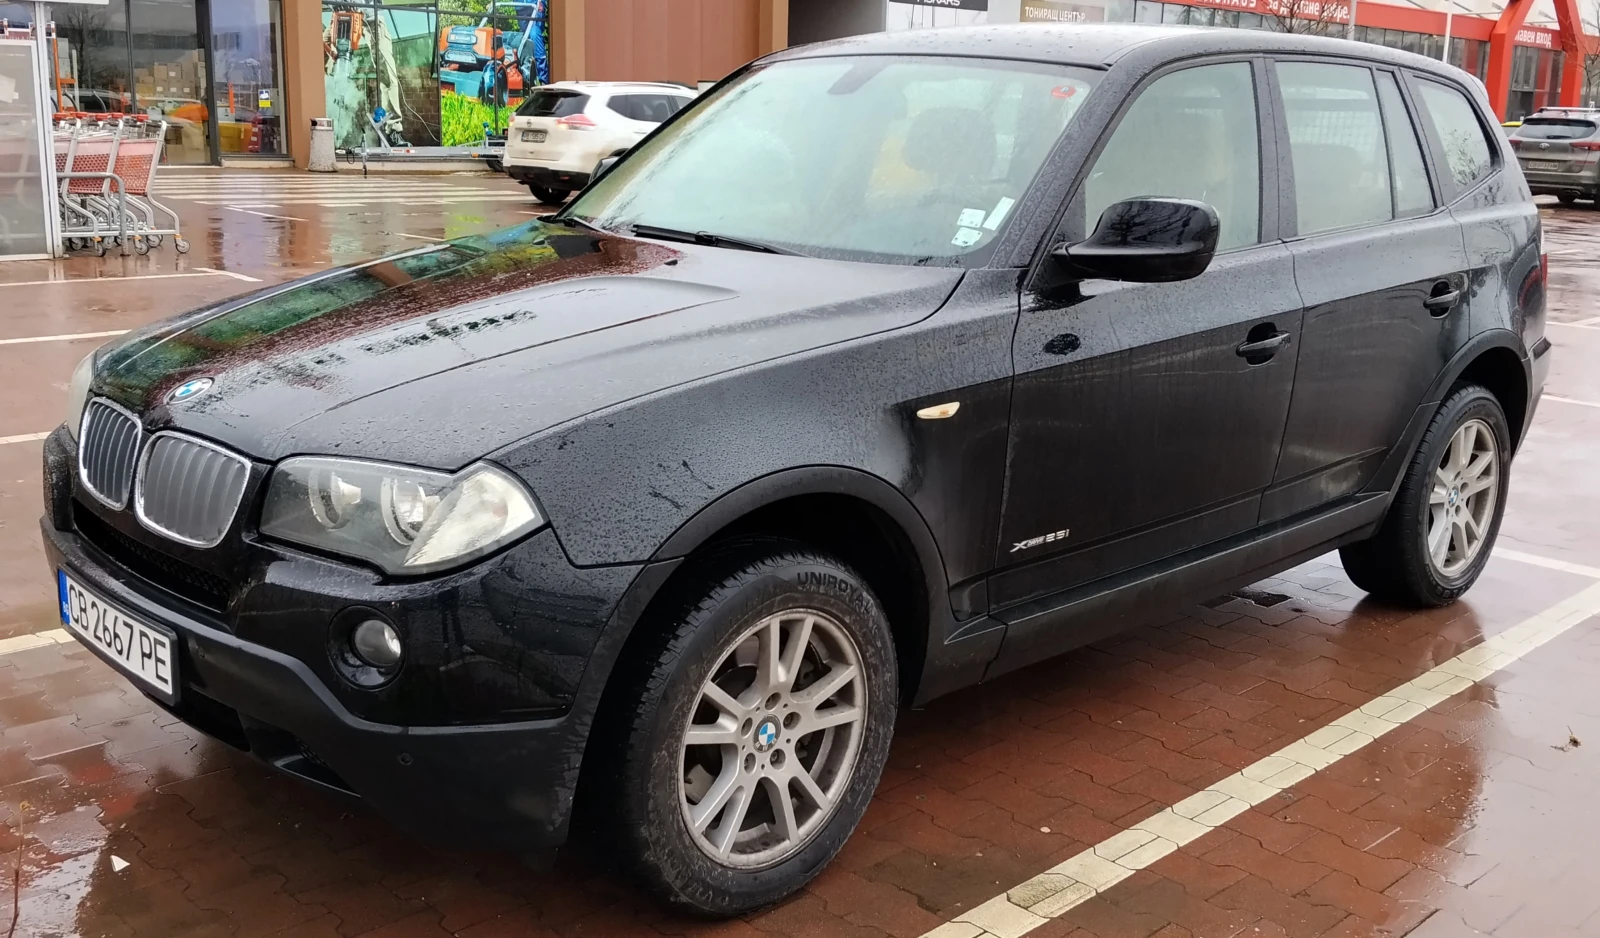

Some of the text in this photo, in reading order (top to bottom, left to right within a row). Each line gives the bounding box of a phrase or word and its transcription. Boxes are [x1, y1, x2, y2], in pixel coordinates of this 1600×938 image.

[1025, 7, 1085, 22] ТОНИРАЩ ЦЕНТЪР
[1514, 29, 1552, 48] лавен вход
[69, 584, 88, 631] CB
[91, 600, 134, 661] 2667
[139, 629, 169, 685] PE
